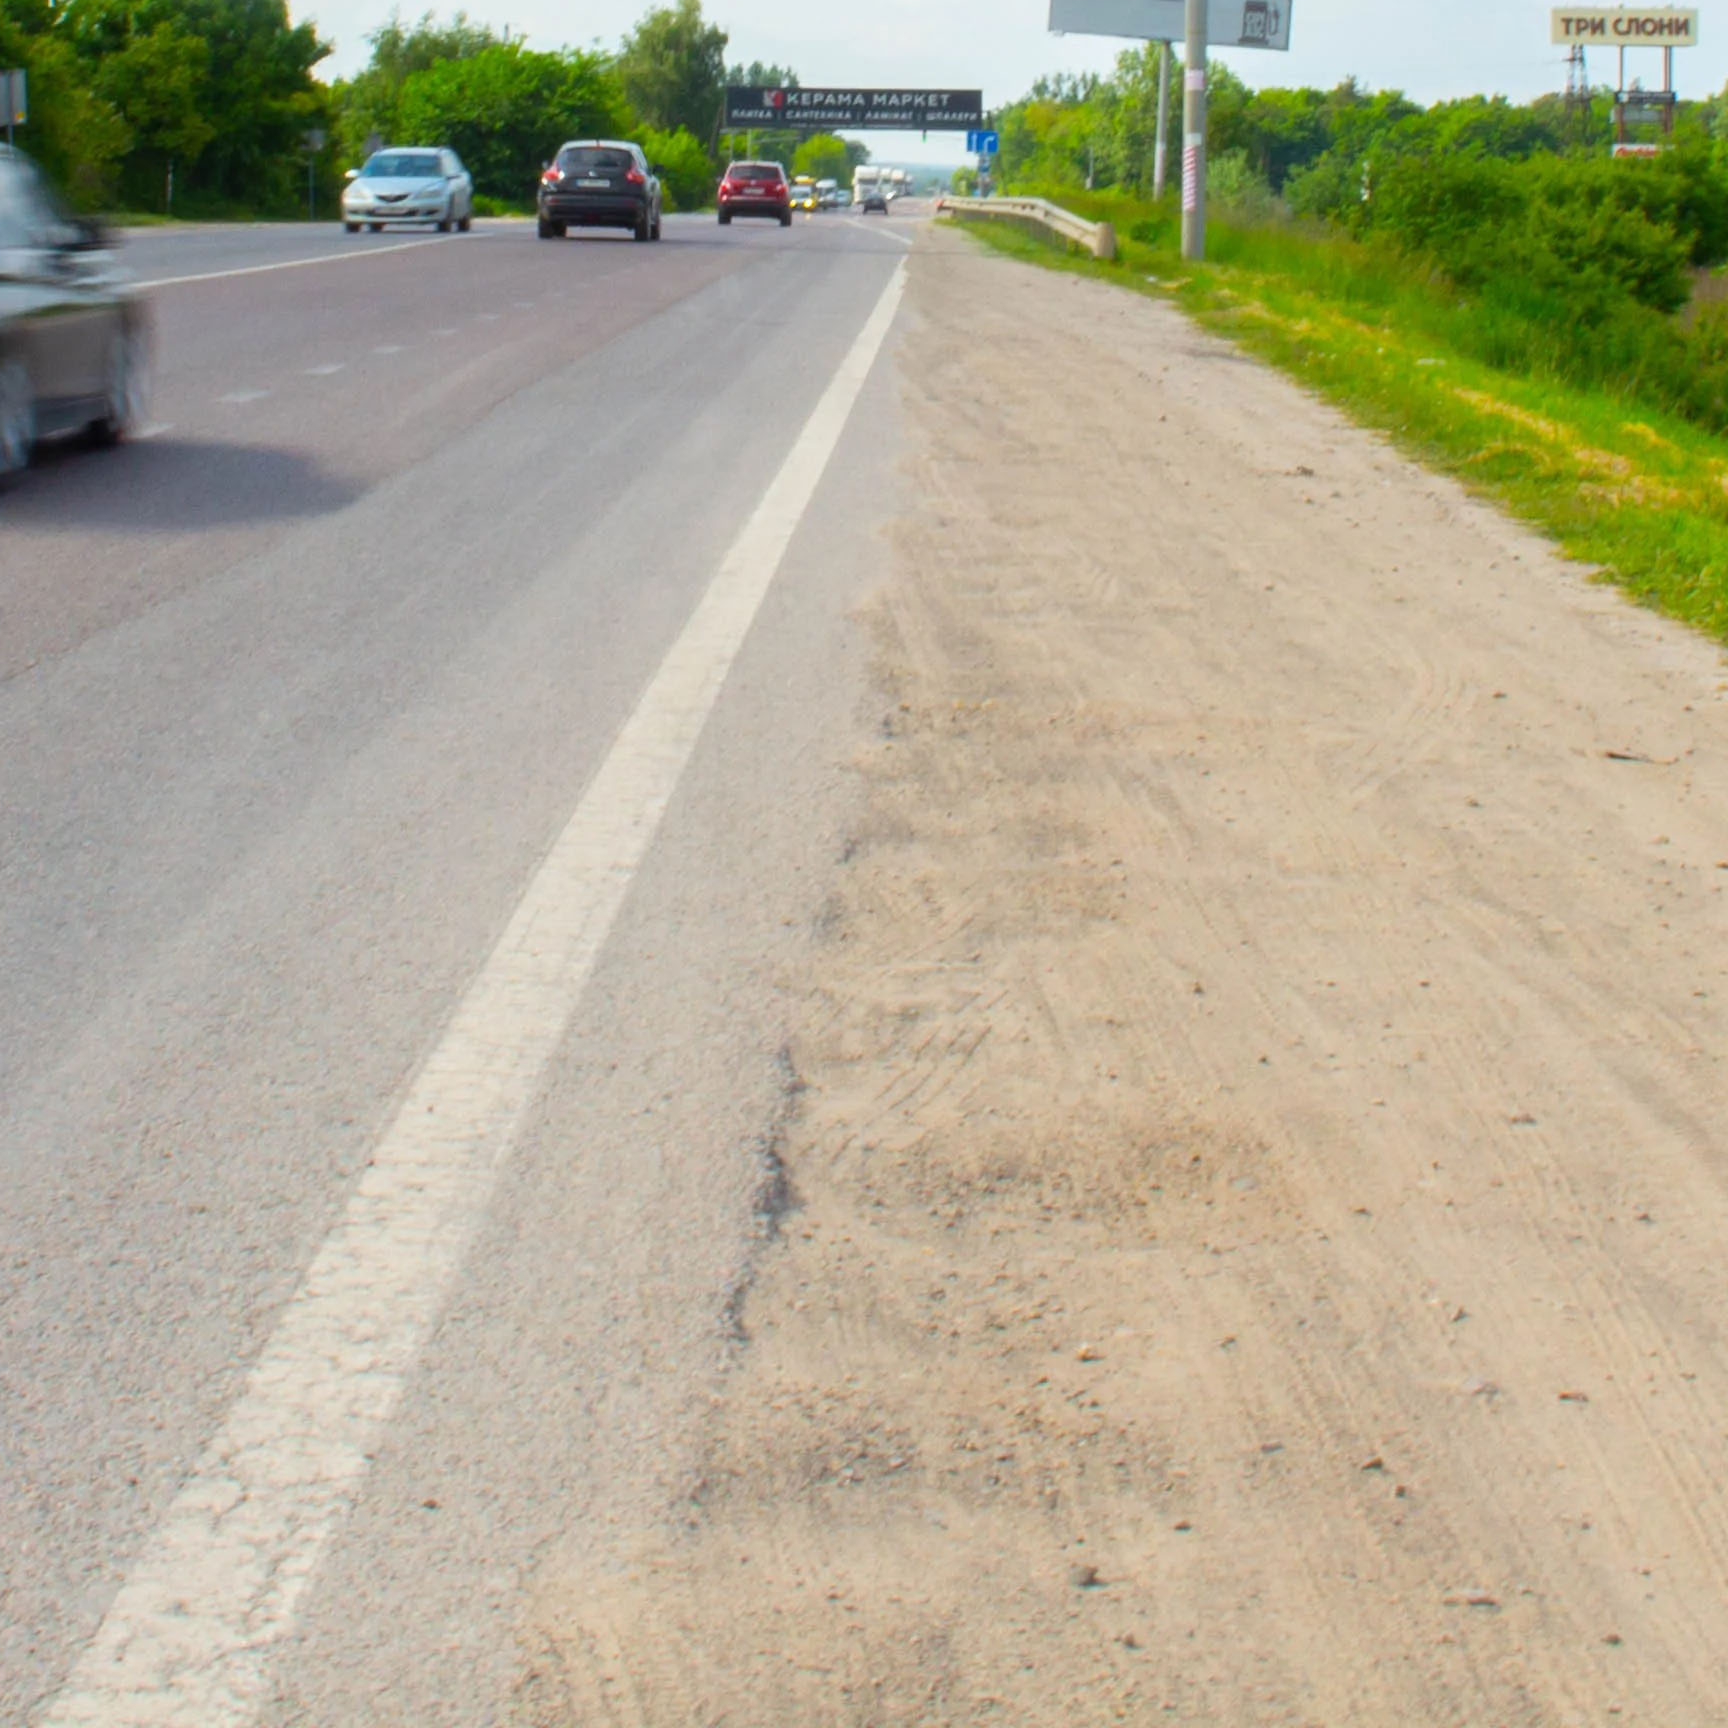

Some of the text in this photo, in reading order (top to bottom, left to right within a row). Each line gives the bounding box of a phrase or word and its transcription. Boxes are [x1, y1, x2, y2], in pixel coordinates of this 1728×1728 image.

[1560, 17, 1690, 36] ТРИ СЛОНИ
[787, 92, 952, 107] КЕРАМА МАРКЕТ
